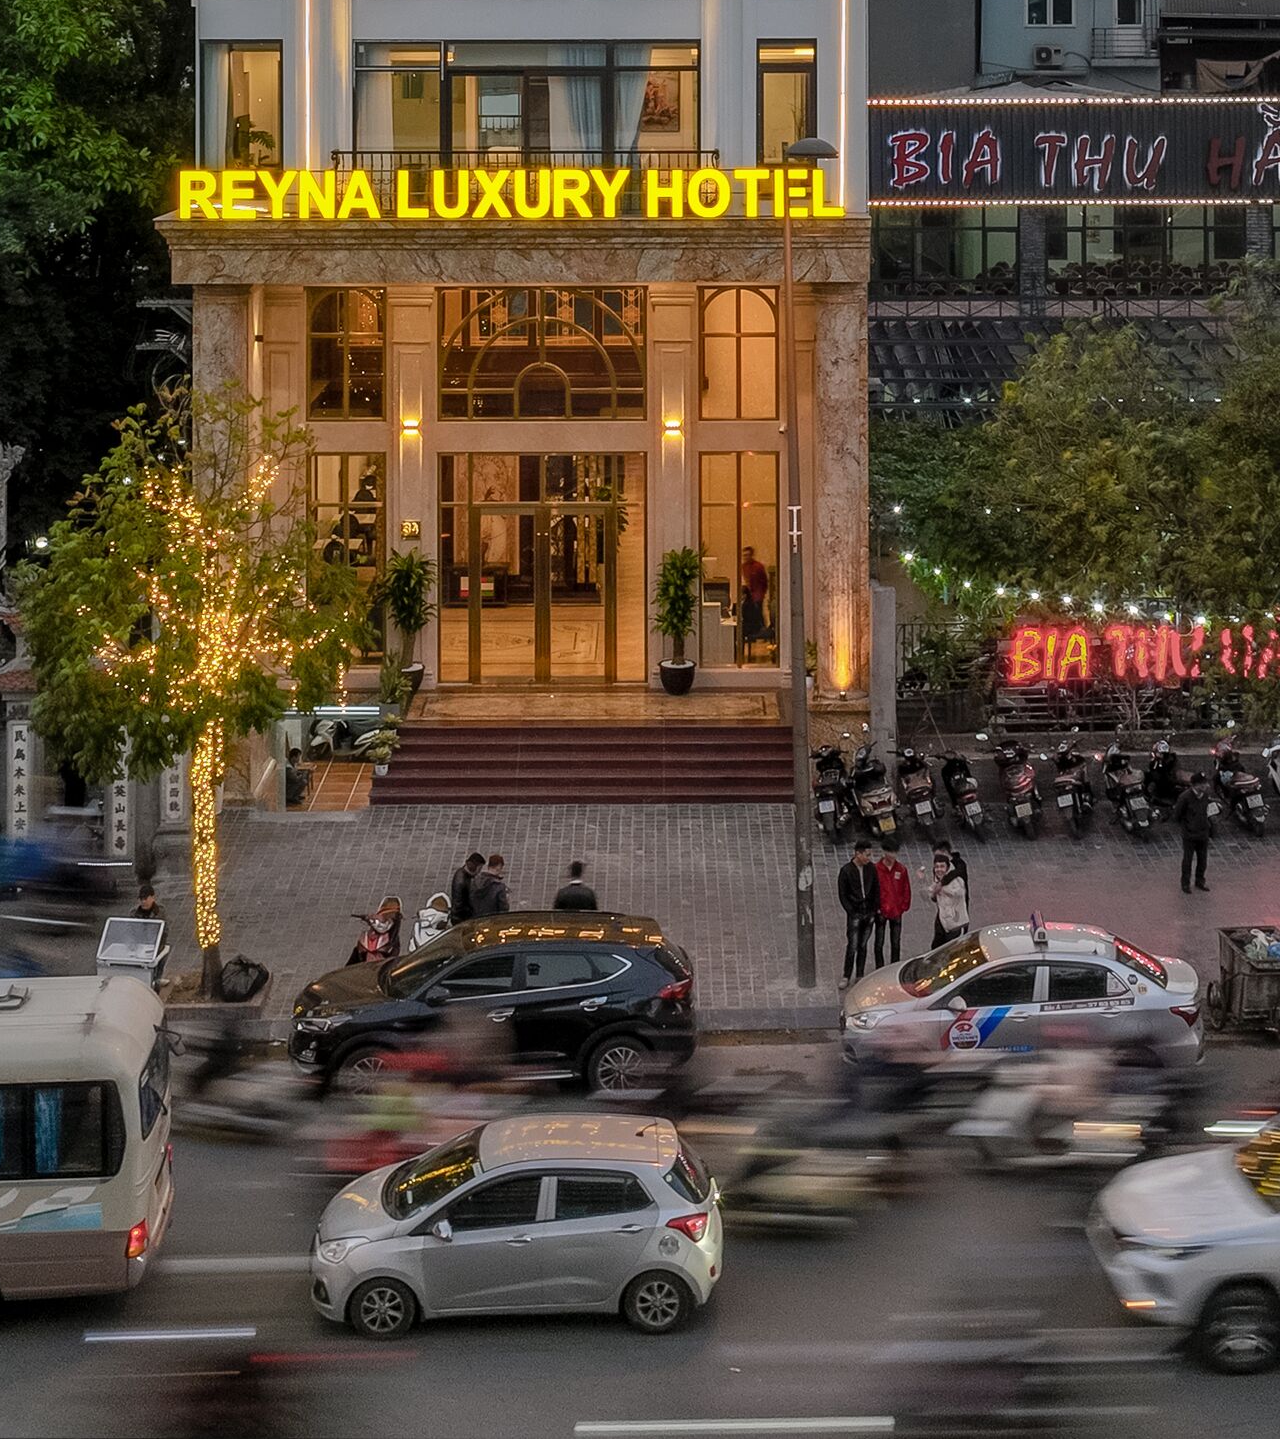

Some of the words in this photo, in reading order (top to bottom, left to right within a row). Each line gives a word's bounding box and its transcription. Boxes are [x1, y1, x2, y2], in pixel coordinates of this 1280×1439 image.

[889, 129, 1001, 190] BIA
[1034, 132, 1168, 192] THU
[178, 169, 382, 220] REYNA
[396, 169, 630, 219] LUXURY
[646, 168, 846, 218] HOTEL
[1008, 624, 1092, 684] BIA
